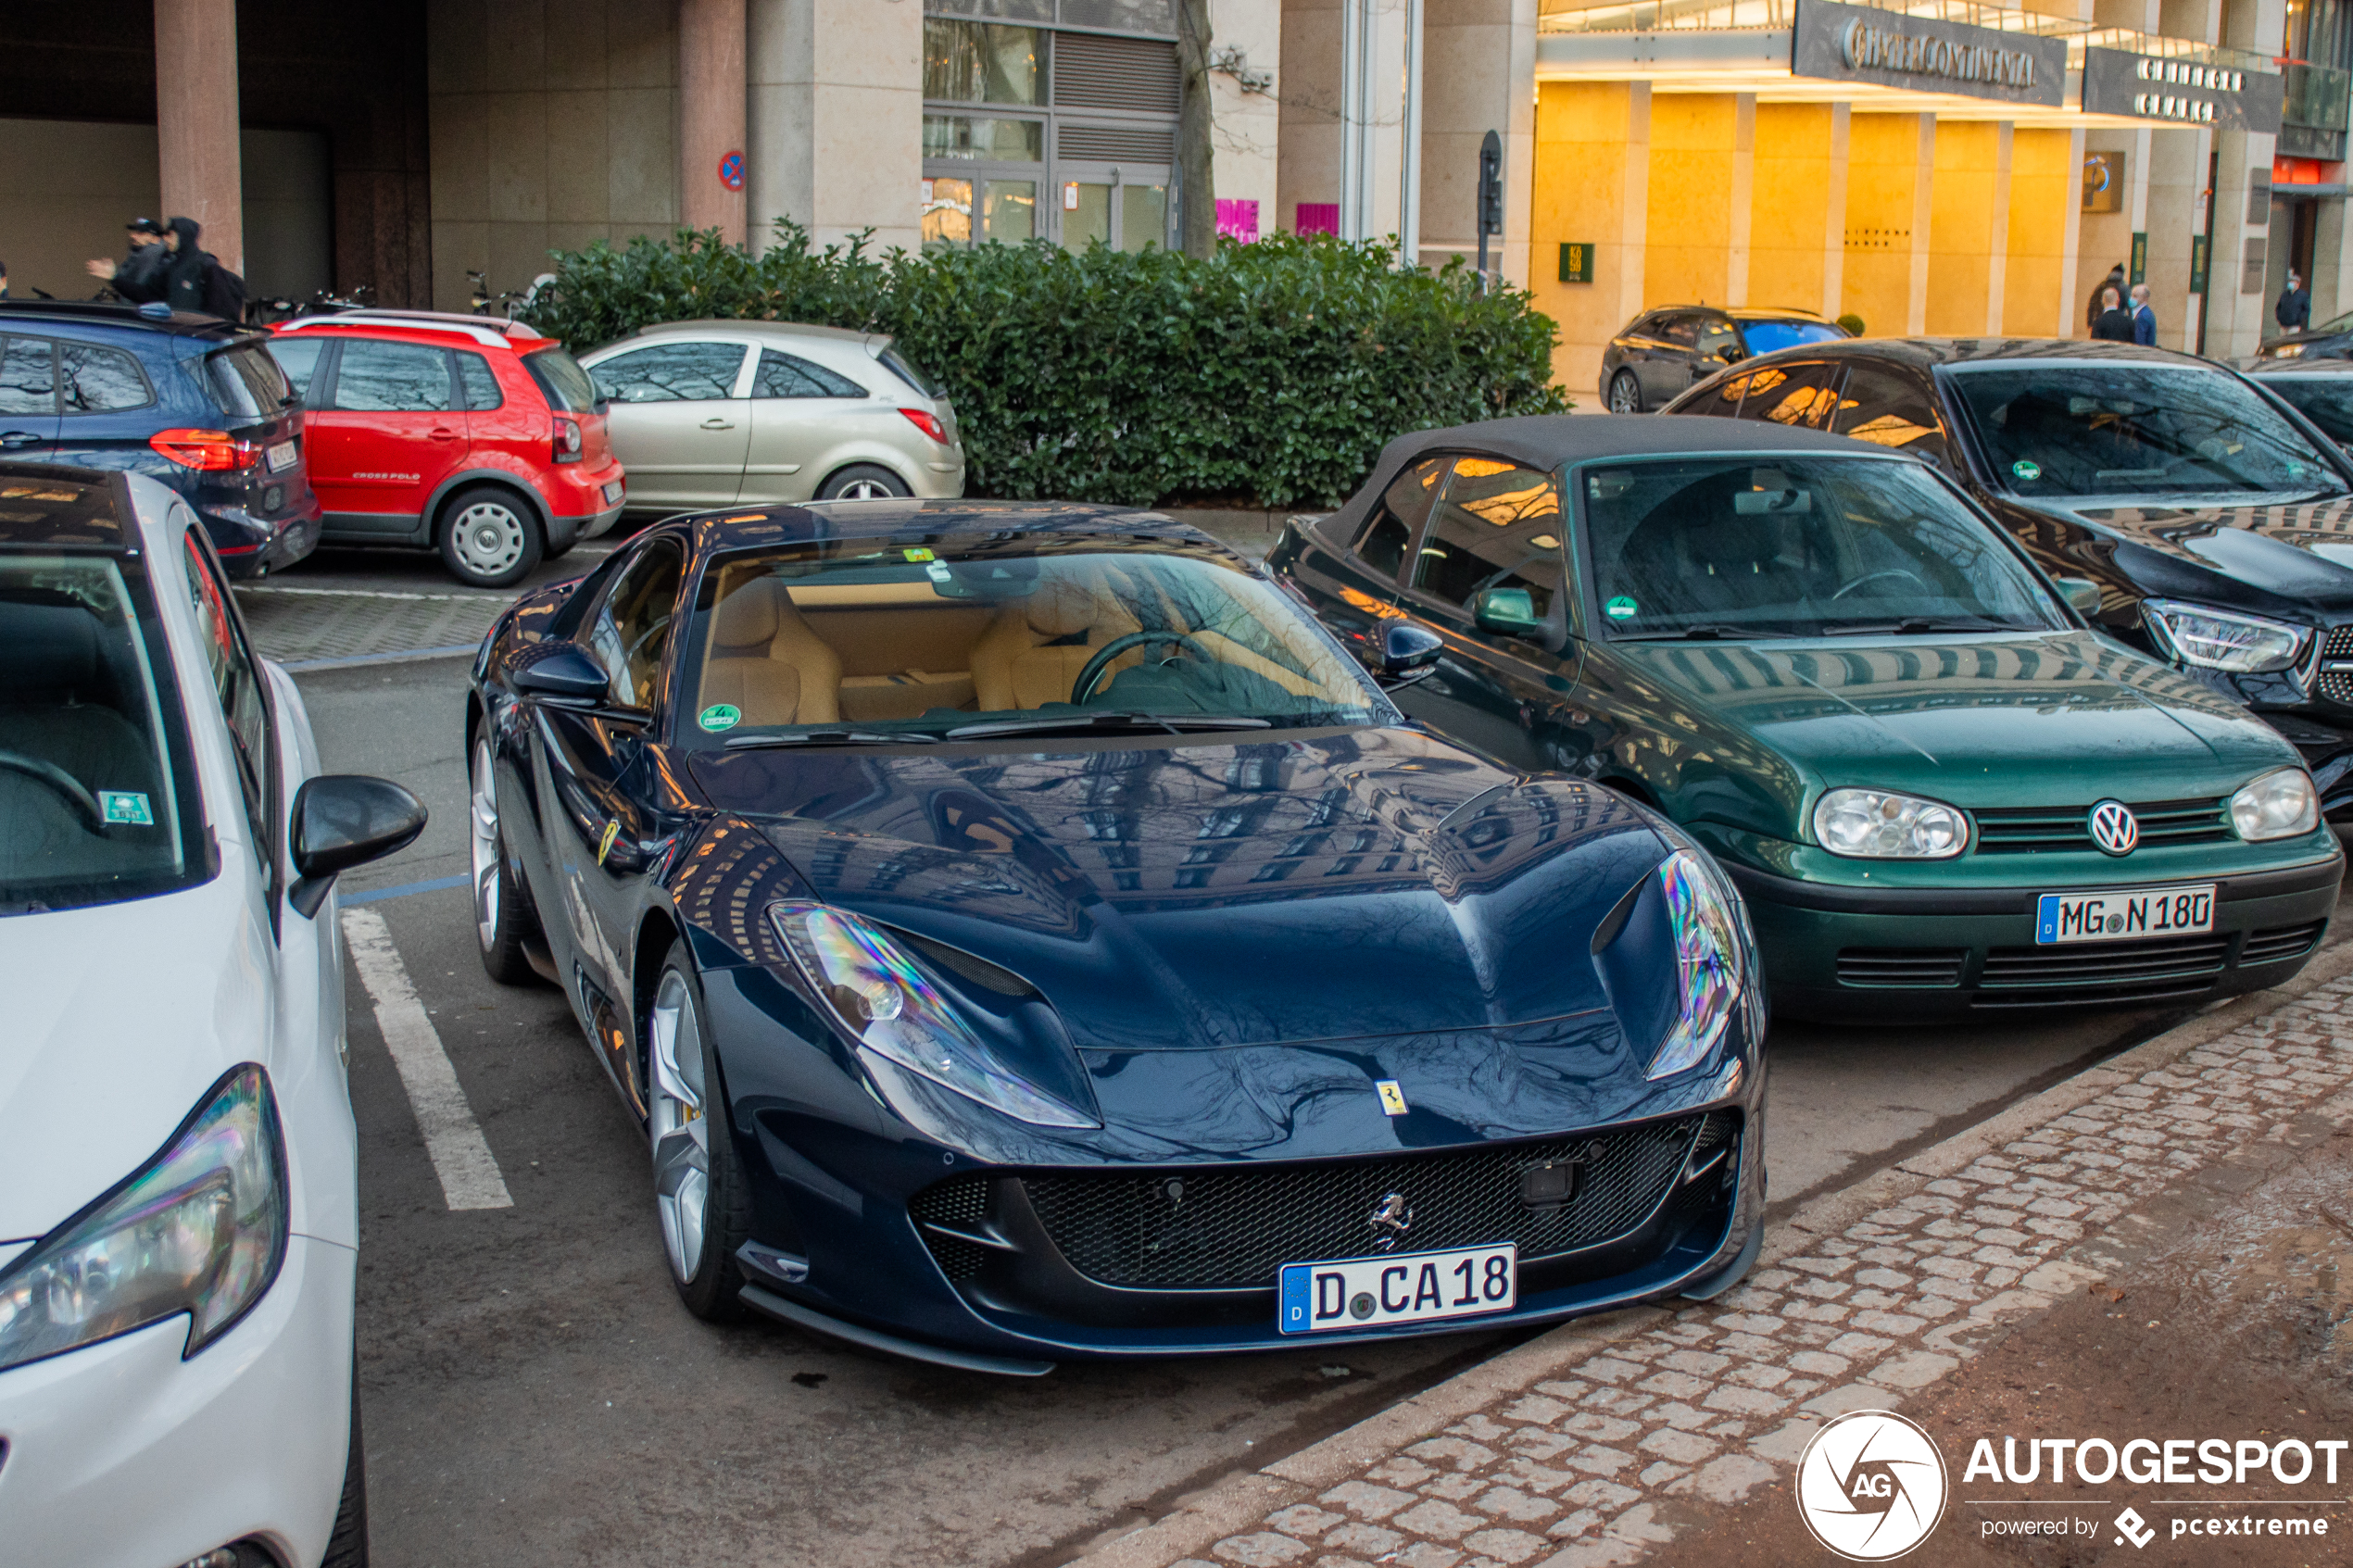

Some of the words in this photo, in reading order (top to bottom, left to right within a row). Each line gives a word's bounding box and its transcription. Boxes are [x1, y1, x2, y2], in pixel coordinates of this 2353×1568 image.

[352, 471, 388, 480] CROSS
[715, 706, 726, 718] 4
[2045, 924, 2053, 935] D
[2060, 900, 2106, 935] MG
[1291, 1307, 1302, 1321] D
[1315, 1272, 1345, 1321] D
